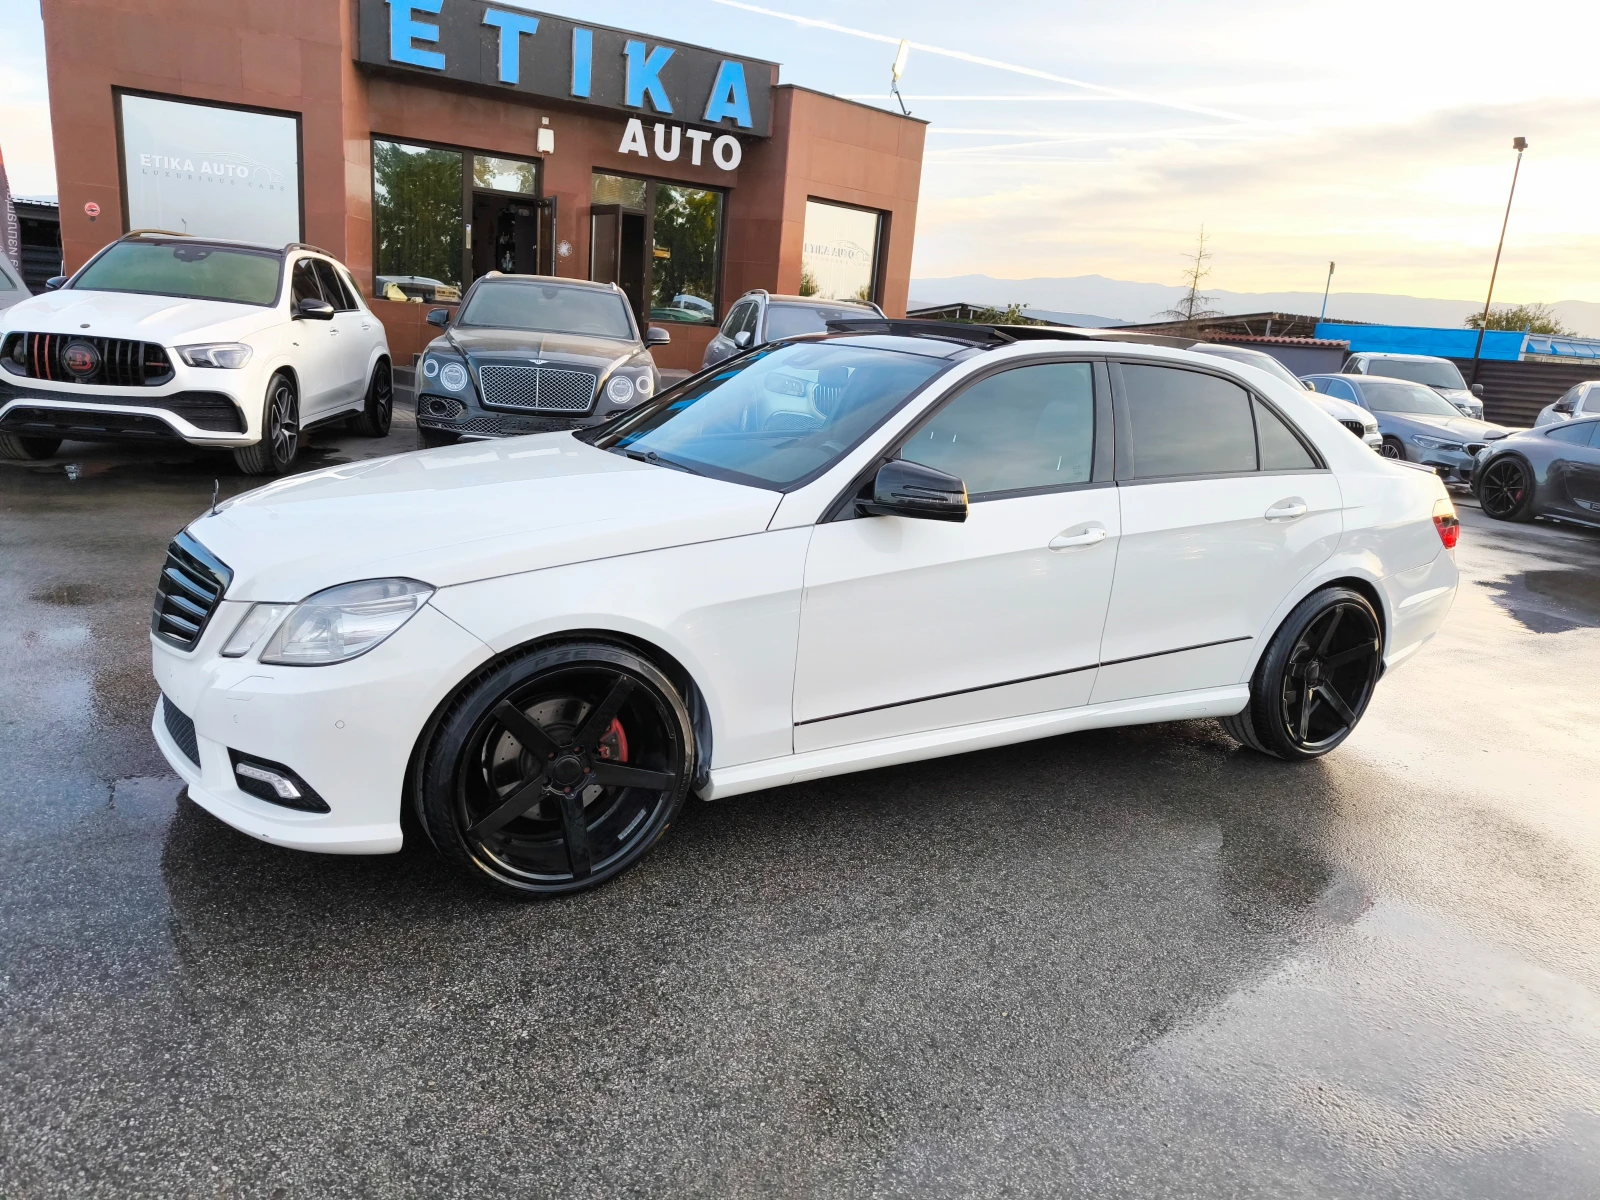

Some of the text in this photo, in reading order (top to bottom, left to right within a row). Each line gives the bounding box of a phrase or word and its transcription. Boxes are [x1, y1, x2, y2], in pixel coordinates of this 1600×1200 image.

[385, 0, 753, 128] ETIKA
[618, 118, 742, 171] AUTO
[140, 153, 249, 179] ETIKA AUTO
[142, 168, 285, 192] LUXURIOUS CARS
